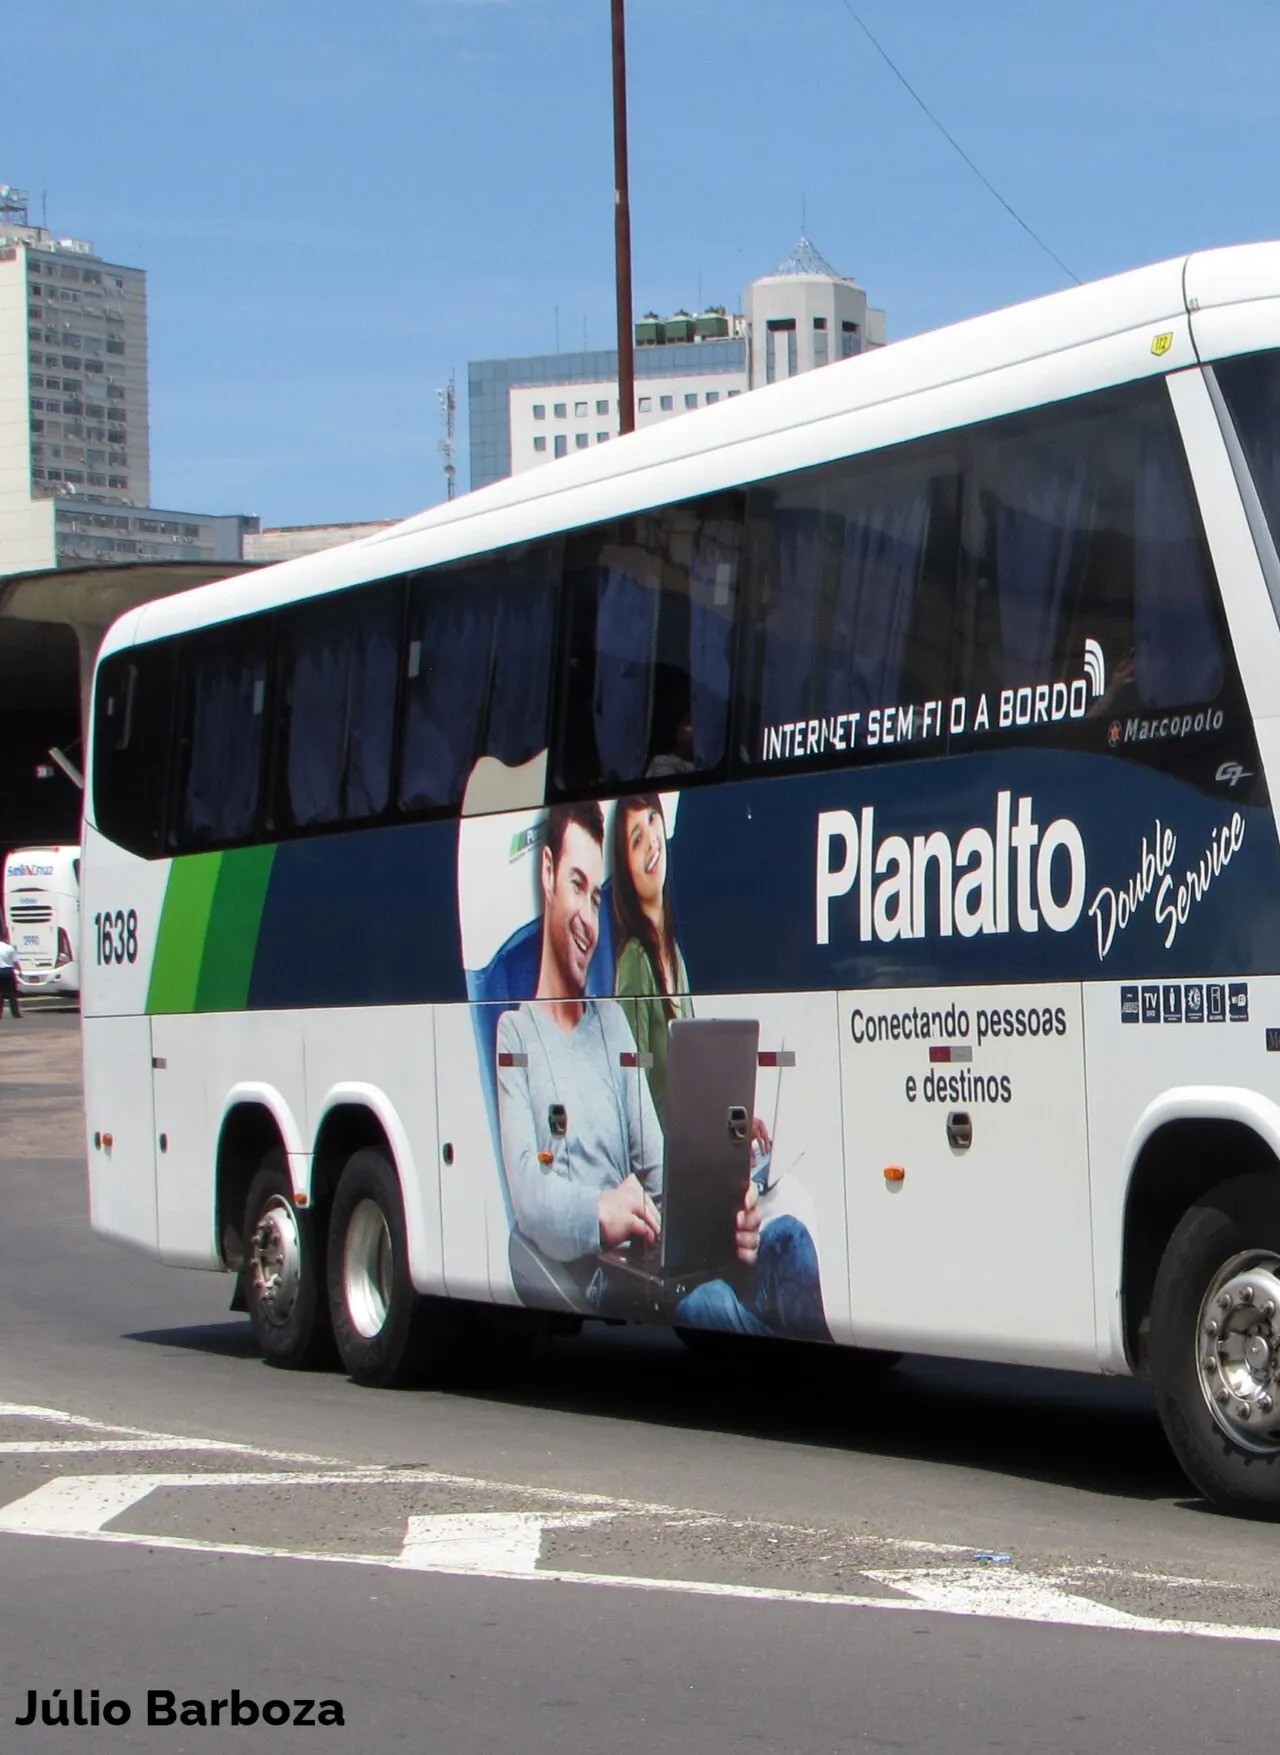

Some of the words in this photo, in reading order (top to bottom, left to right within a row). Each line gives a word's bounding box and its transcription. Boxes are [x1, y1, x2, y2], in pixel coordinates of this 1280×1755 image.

[762, 712, 860, 760] INTERNET
[866, 704, 913, 745] SEM
[973, 693, 989, 731] A
[1000, 679, 1087, 728] BORDO
[1123, 708, 1224, 743] Marcopolo
[815, 790, 1087, 945] Planalto
[1088, 818, 1177, 962] Double
[1155, 811, 1246, 949] Service
[94, 908, 138, 965] 1638
[851, 1002, 970, 1043] Conectando
[976, 1007, 1067, 1047] pessoas
[1144, 992, 1157, 1008] TV
[905, 1075, 917, 1102] e
[923, 1068, 1012, 1103] destinos
